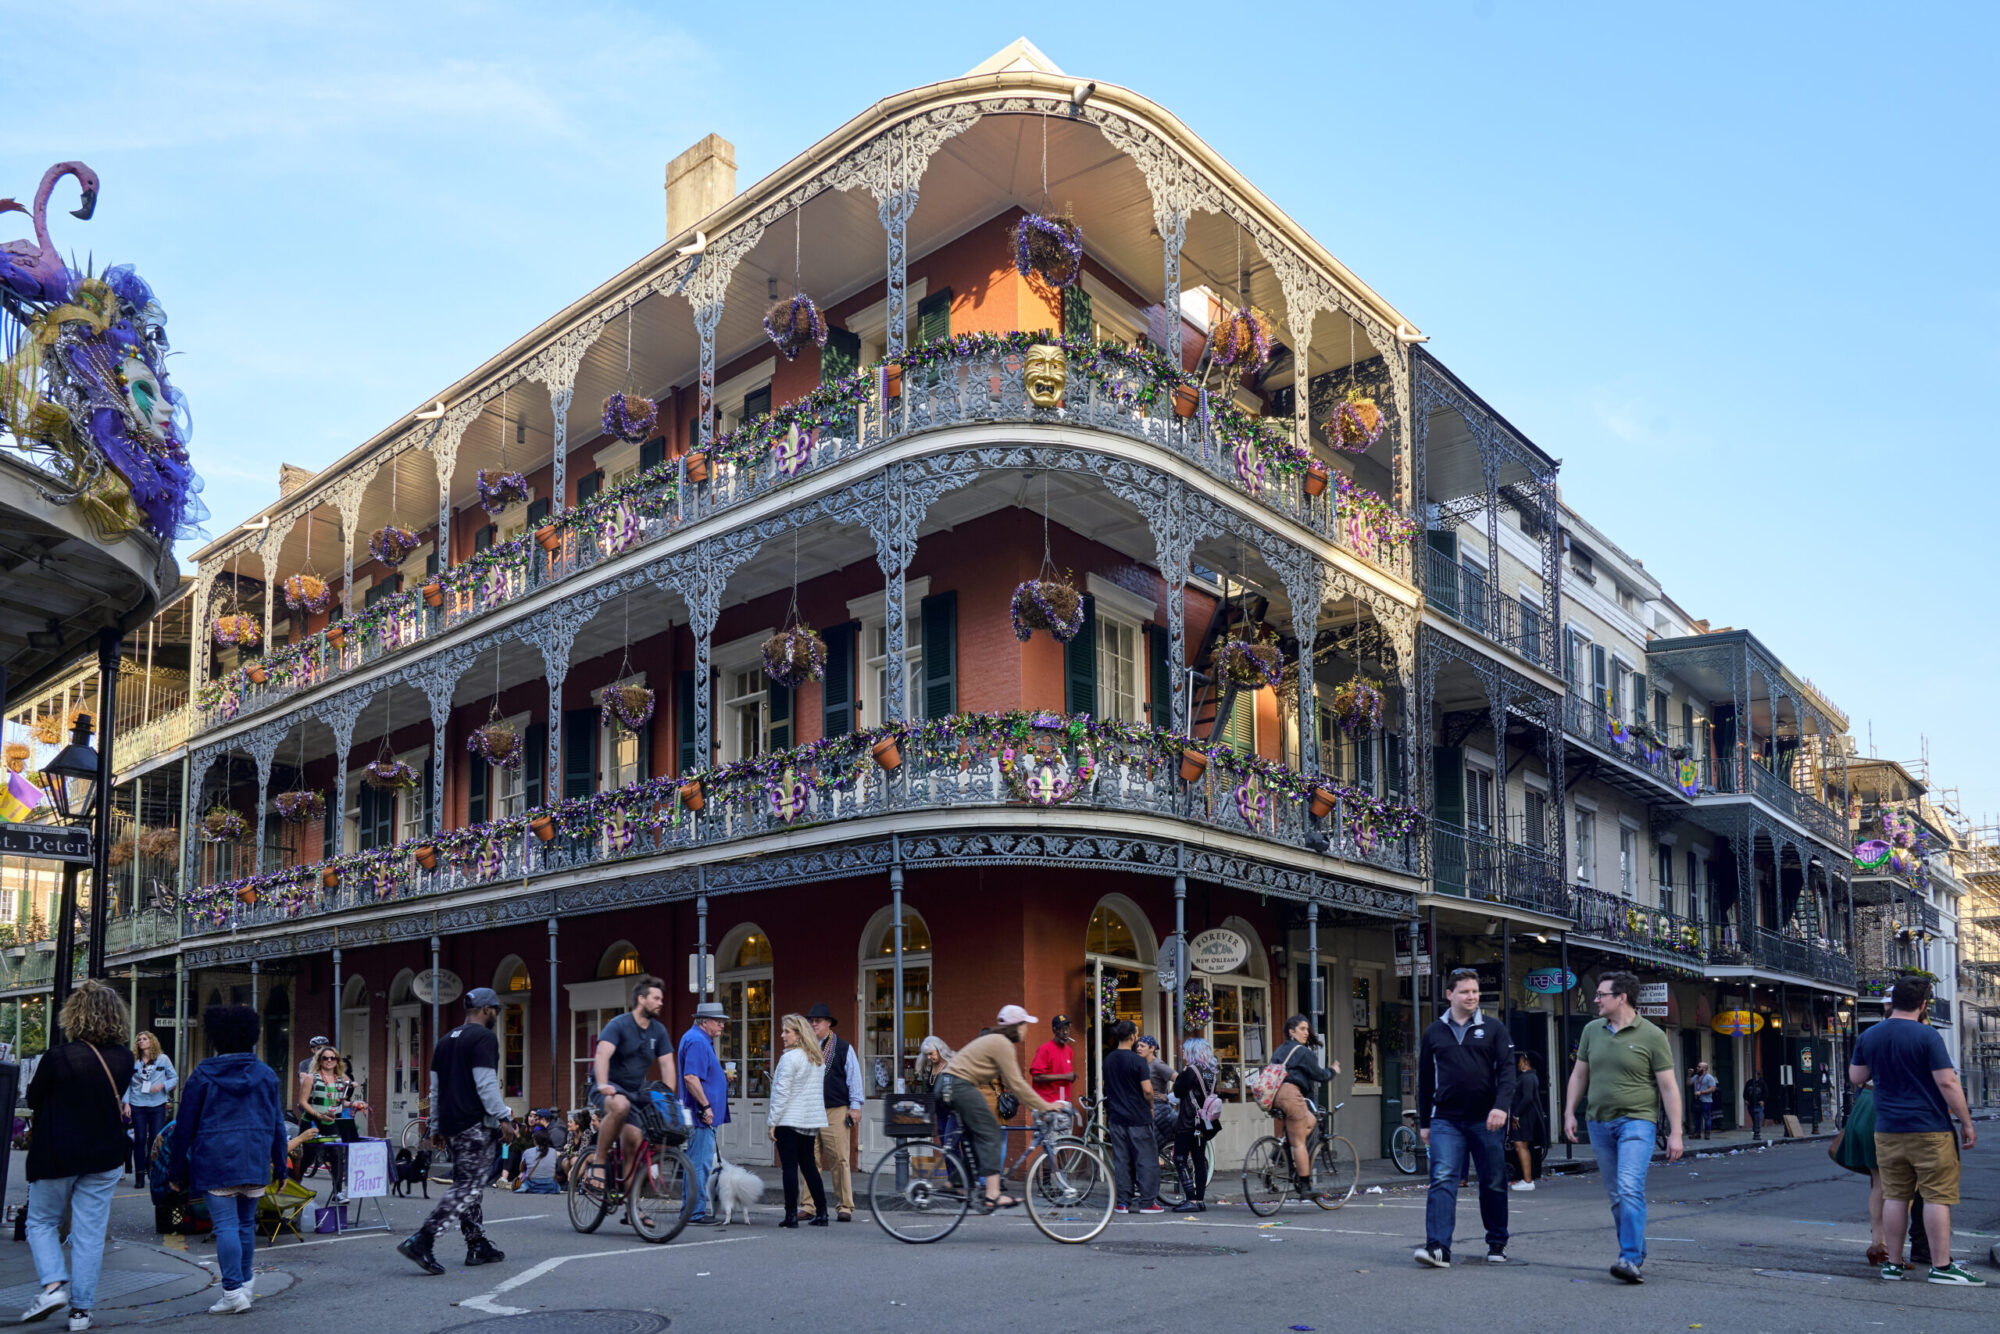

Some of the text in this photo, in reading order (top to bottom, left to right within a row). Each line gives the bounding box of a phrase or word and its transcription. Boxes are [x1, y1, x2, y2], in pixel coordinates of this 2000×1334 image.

[0, 834, 86, 854] t. Peter
[1196, 932, 1239, 948] FOREVER
[1528, 972, 1572, 990] TRENDZ
[354, 1147, 381, 1167] FACE
[354, 1169, 383, 1192] PAINT
